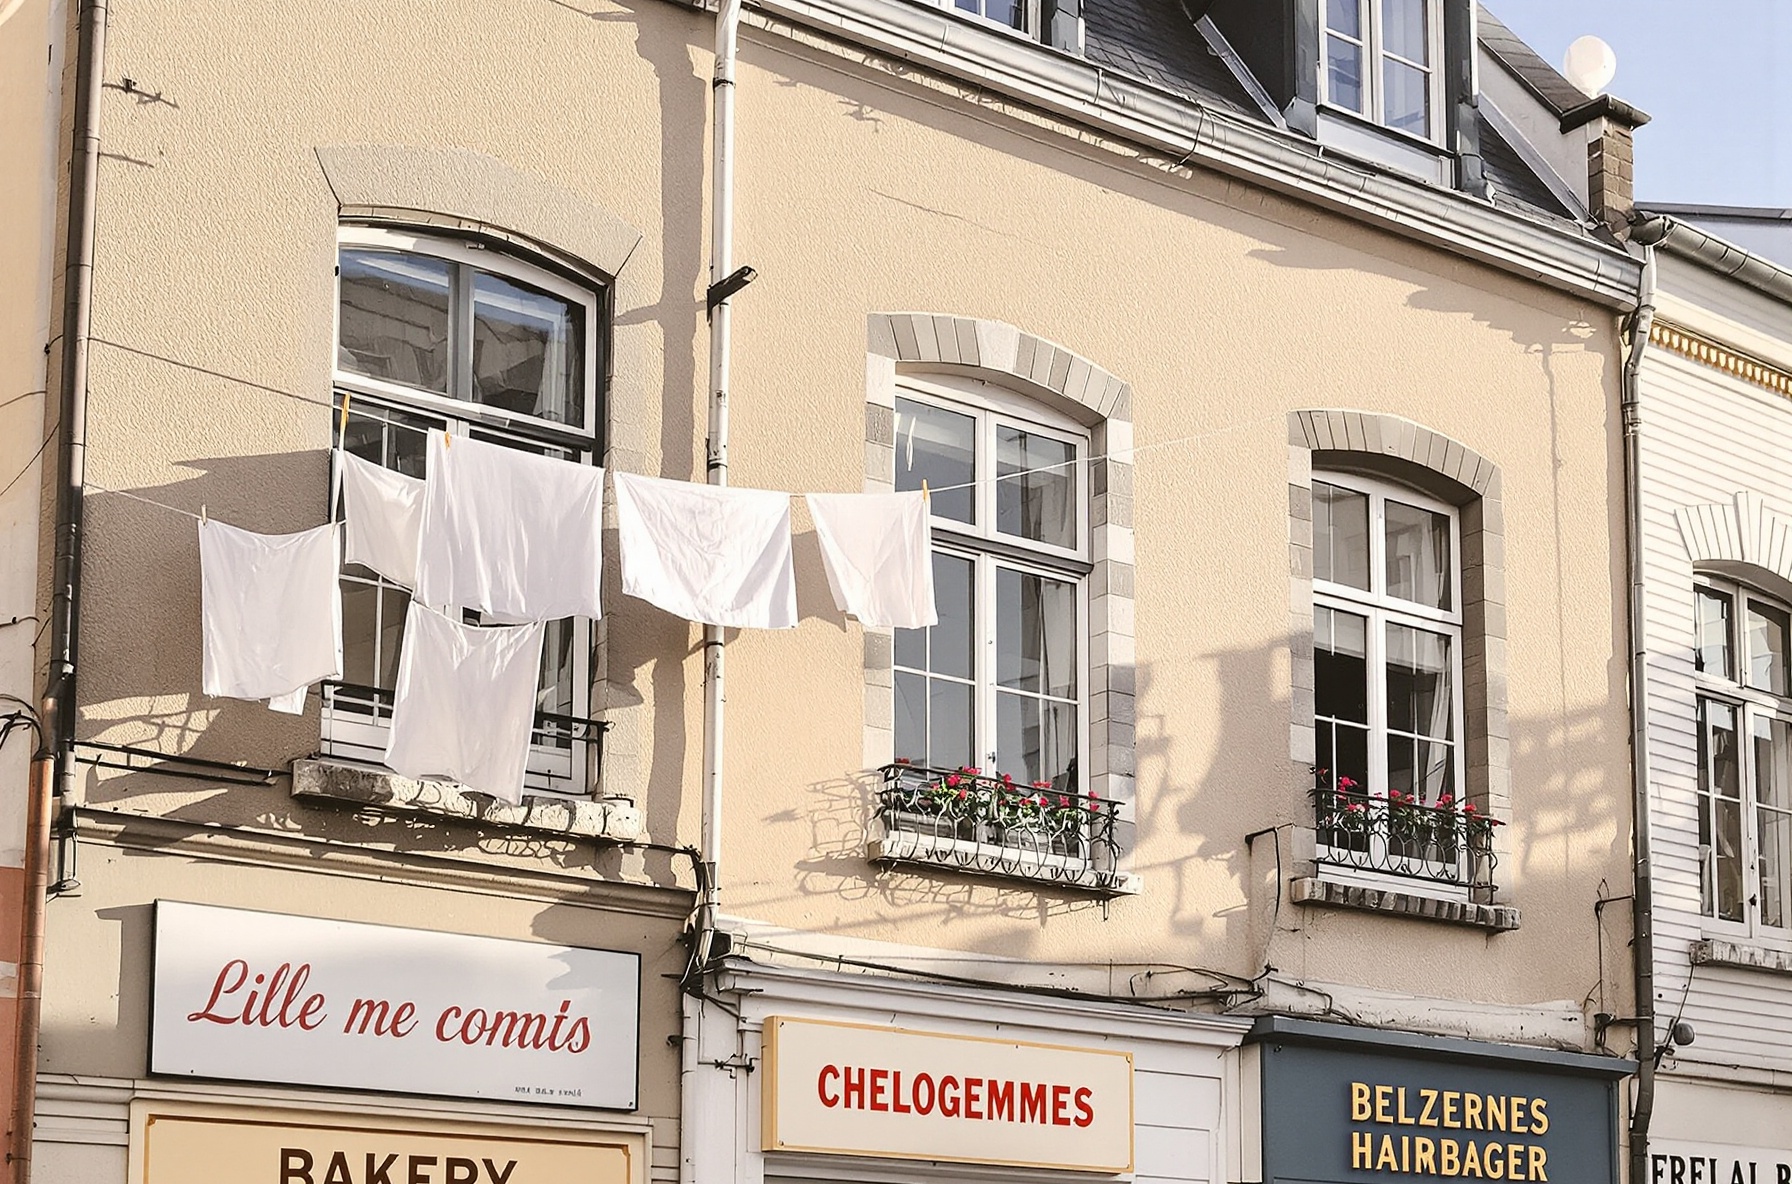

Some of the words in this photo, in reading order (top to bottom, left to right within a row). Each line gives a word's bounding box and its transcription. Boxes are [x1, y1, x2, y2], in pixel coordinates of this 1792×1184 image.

[187, 959, 327, 1031] Lille
[343, 998, 419, 1038] me
[818, 1064, 1094, 1128] CHELOGEMMES
[1351, 1082, 1549, 1136] BELZERNES
[1351, 1131, 1548, 1182] HAIRBAGER
